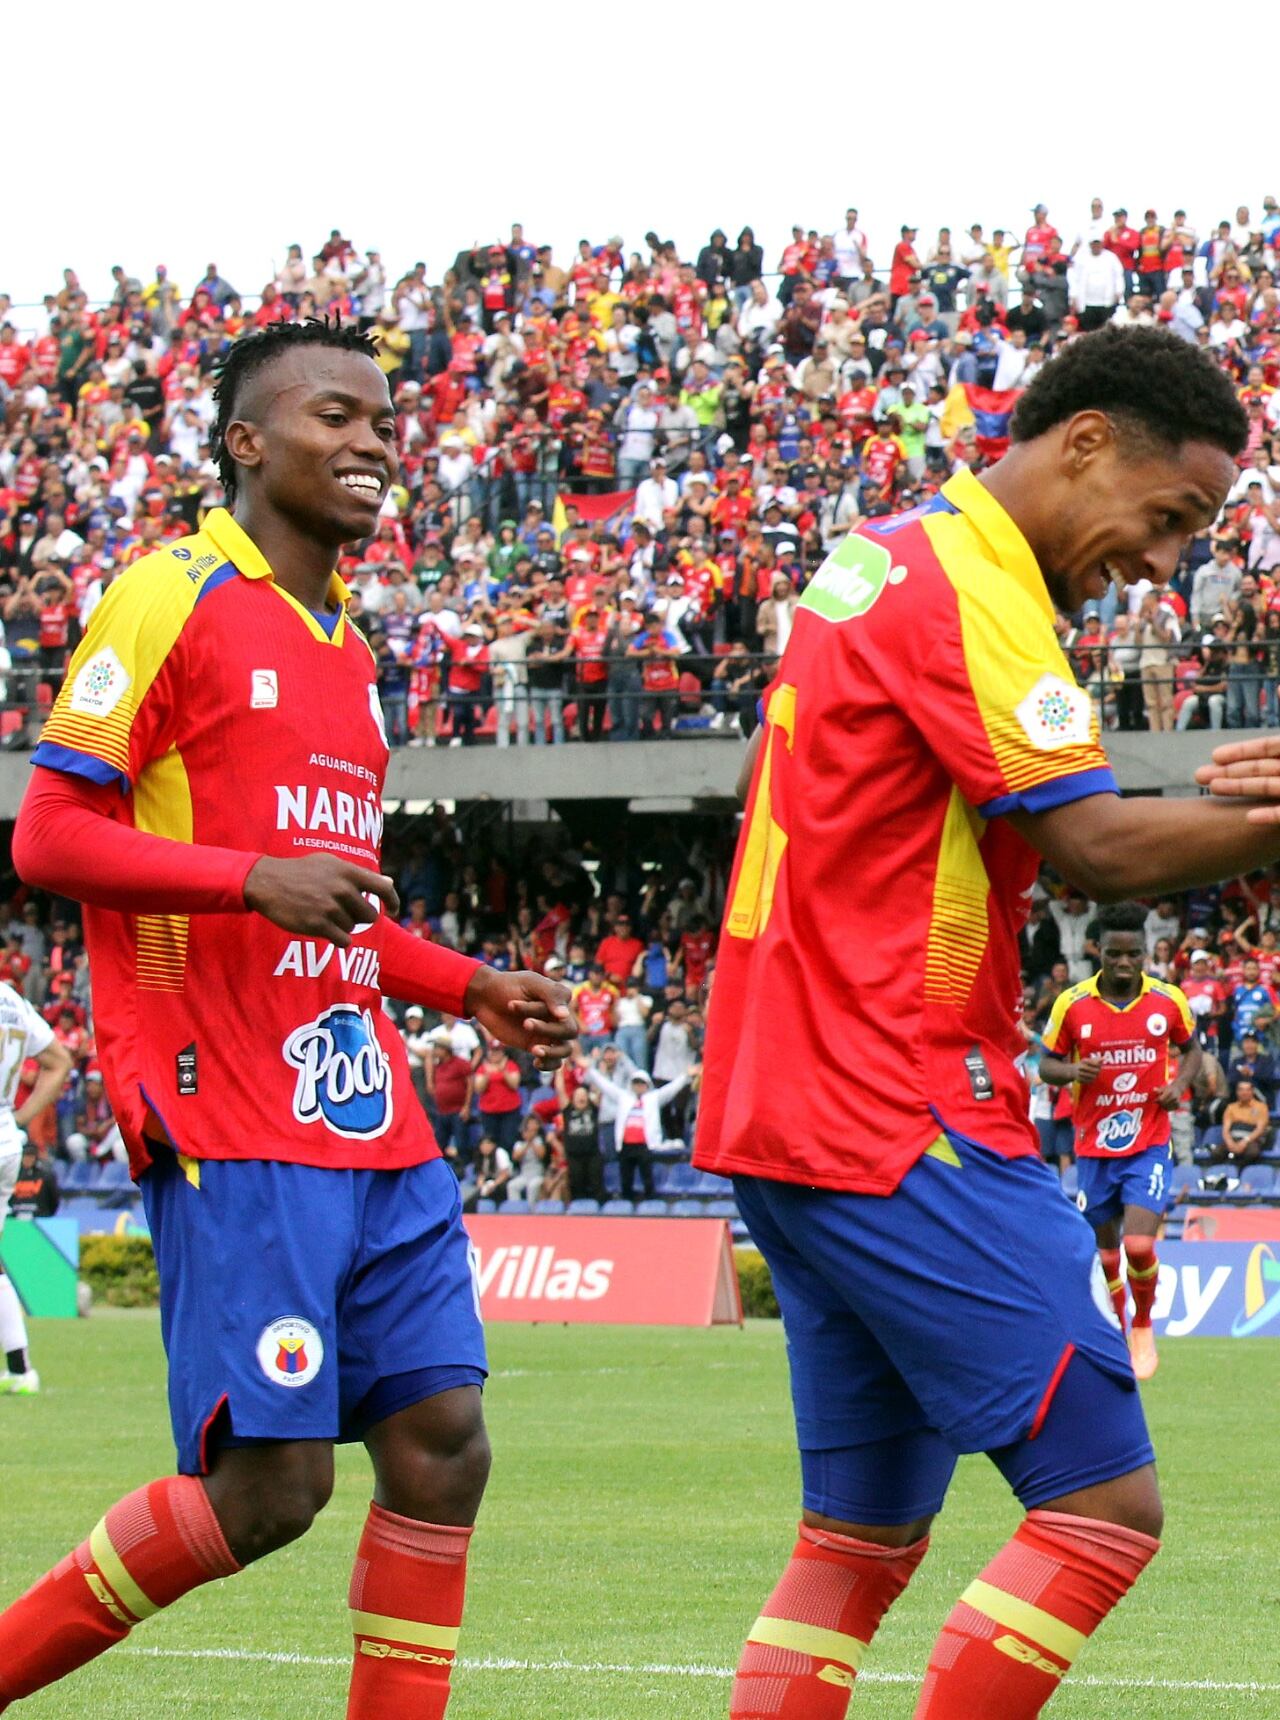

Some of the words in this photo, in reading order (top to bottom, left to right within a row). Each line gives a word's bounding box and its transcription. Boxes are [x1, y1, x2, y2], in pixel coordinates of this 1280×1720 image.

[309, 753, 378, 787] AGUARDIENTE
[274, 785, 384, 850] NARIÑ
[293, 837, 305, 847] LA
[306, 838, 341, 851] ESENCIA
[273, 940, 334, 978] AV
[0, 1028, 27, 1098] 7
[290, 1008, 387, 1115] Pool
[1096, 1094, 1113, 1106] AV
[1096, 1107, 1144, 1149] Pool
[473, 1246, 615, 1300] Villas
